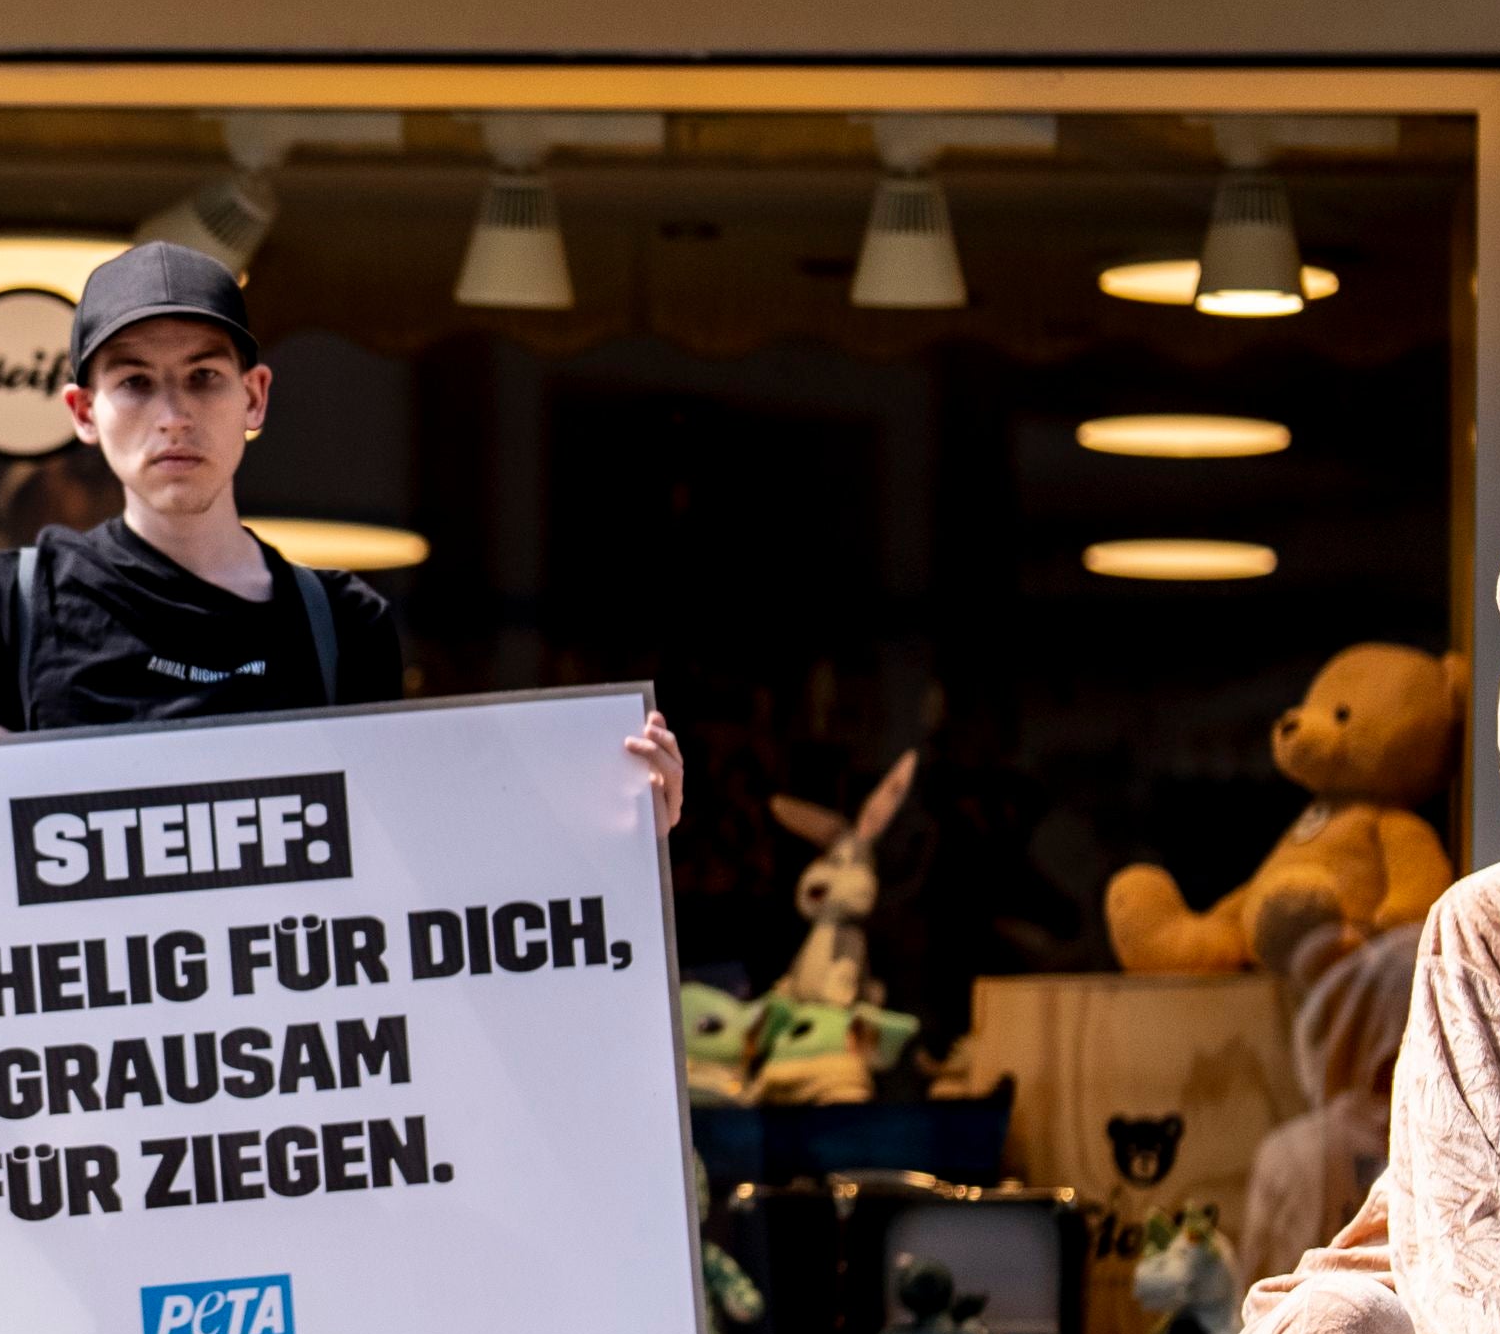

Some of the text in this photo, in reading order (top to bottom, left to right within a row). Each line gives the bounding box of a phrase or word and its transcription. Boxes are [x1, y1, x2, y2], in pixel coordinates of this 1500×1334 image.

[147, 655, 187, 681] ANIMAL
[32, 793, 330, 887] STEIFF:
[228, 914, 389, 995] FÜR
[407, 895, 632, 980] DICH,
[140, 1115, 454, 1210] ZIEGEN.
